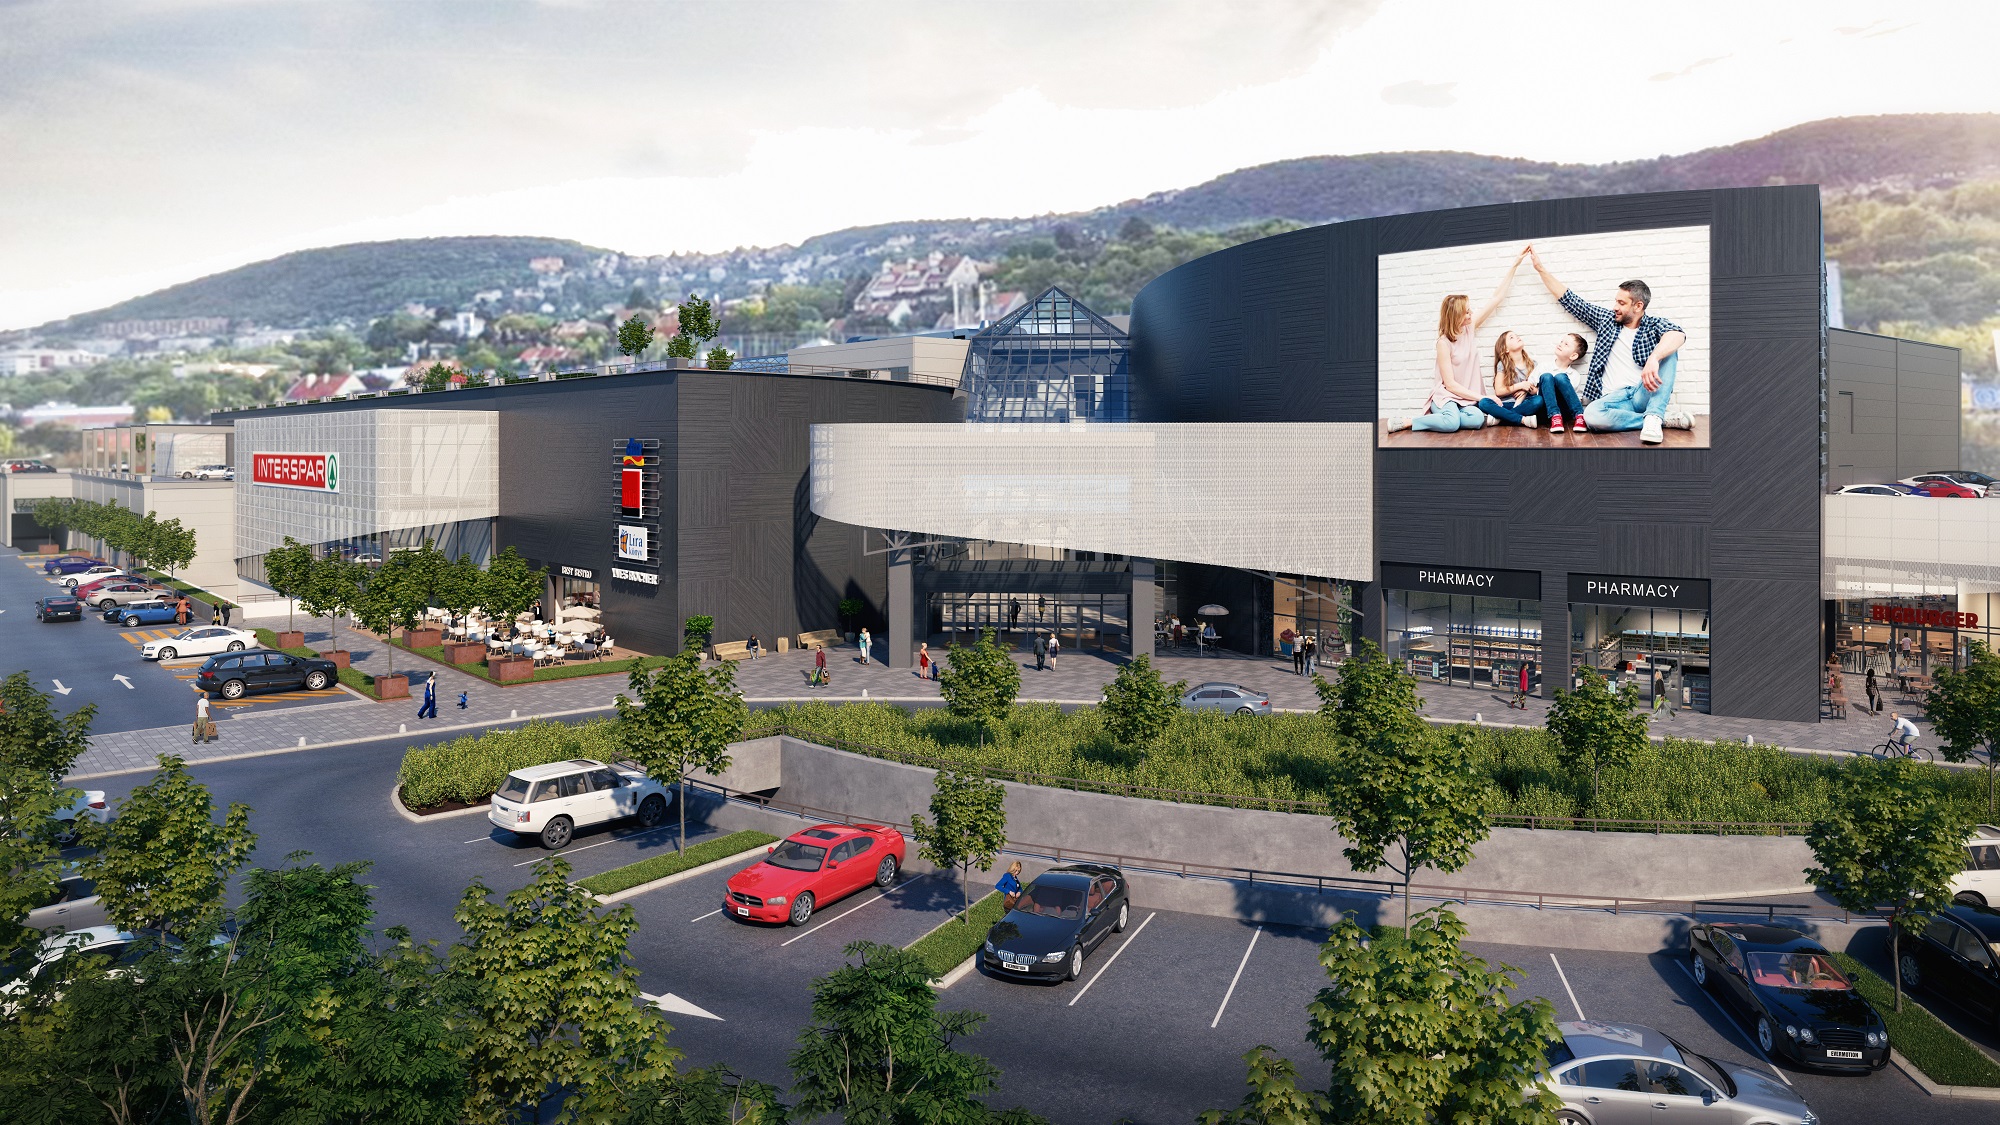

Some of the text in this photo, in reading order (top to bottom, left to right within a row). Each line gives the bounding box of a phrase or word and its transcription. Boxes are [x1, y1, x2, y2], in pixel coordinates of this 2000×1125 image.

[258, 458, 324, 482] INTERSPAR
[629, 534, 643, 547] Lira
[1419, 571, 1494, 587] PHARMACY
[1587, 581, 1679, 597] PHARMACY
[1872, 605, 1979, 629] BIGBURGER
